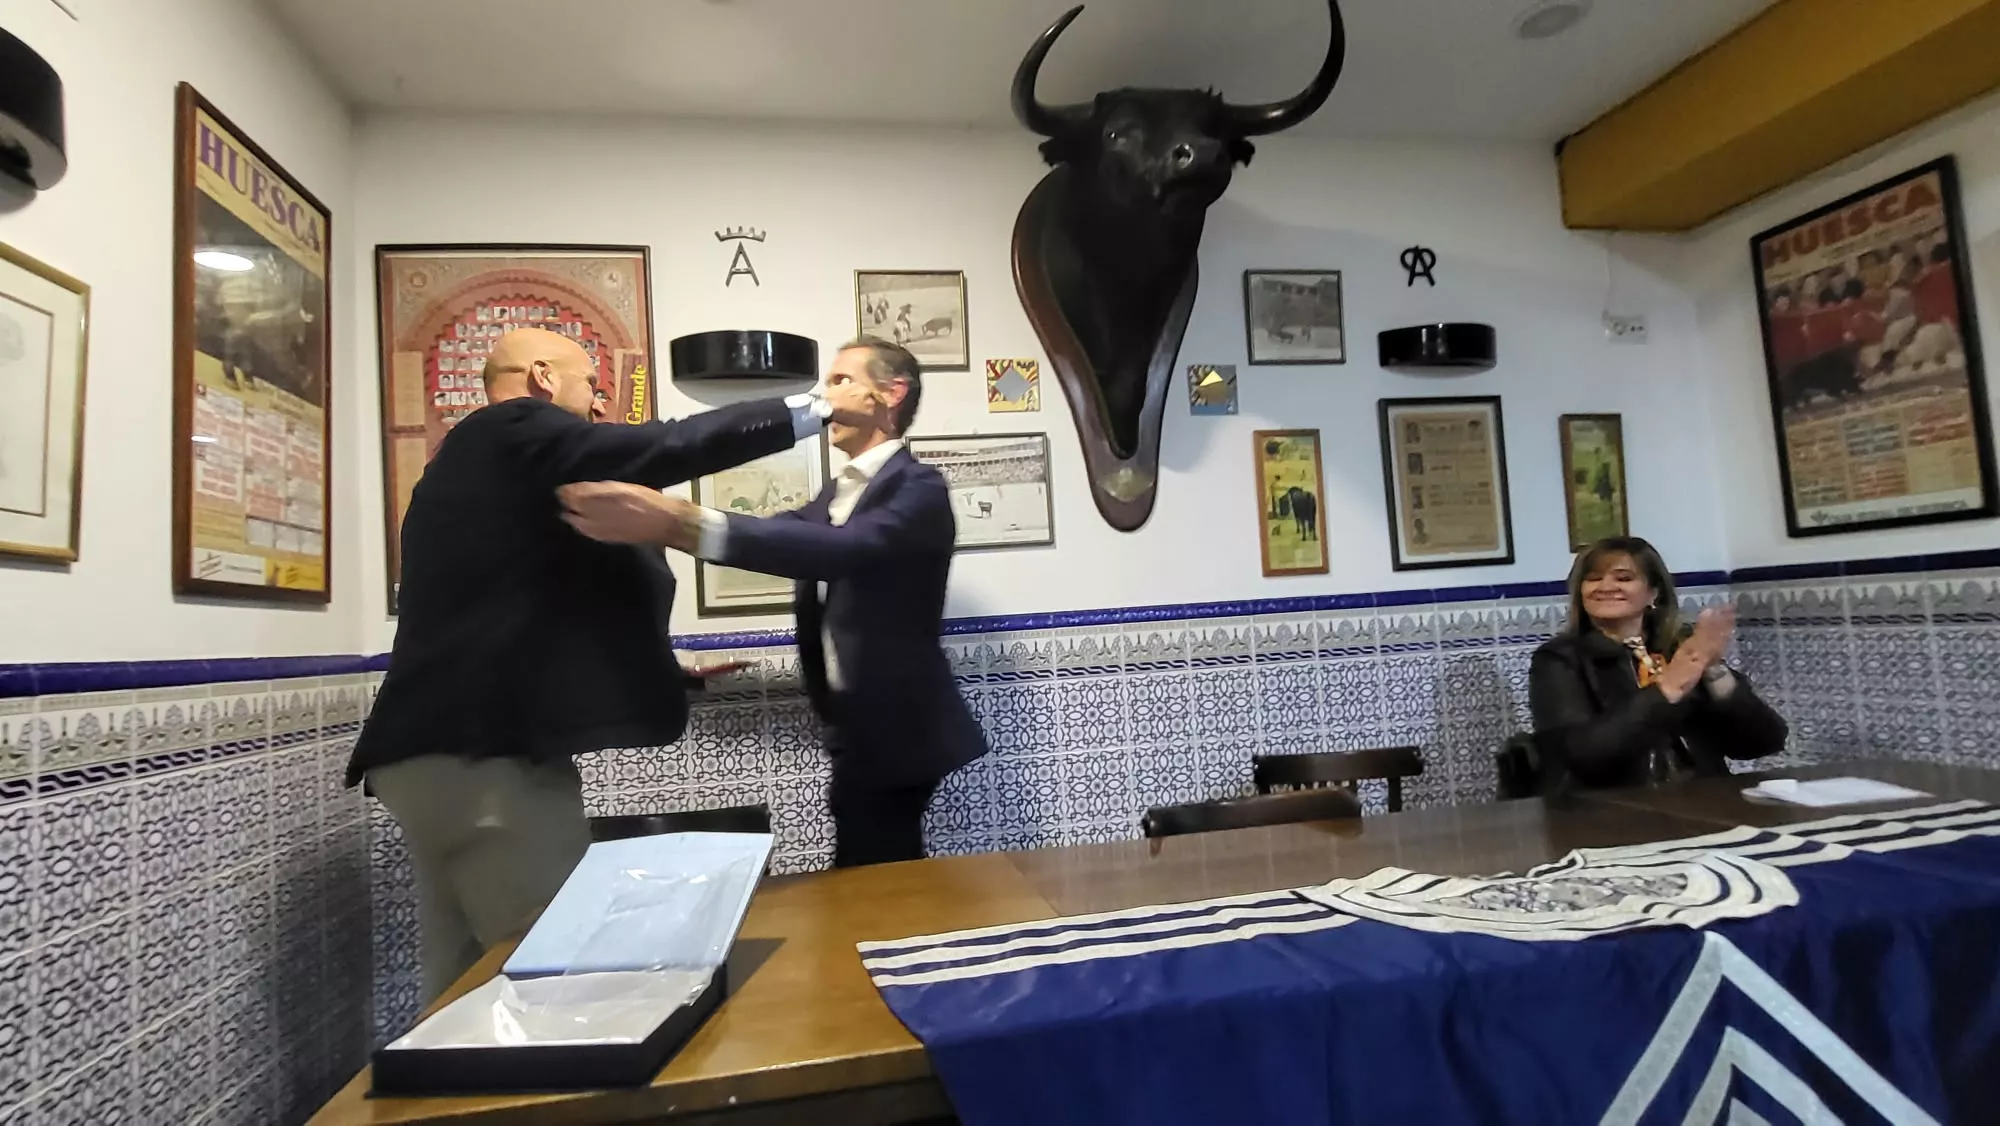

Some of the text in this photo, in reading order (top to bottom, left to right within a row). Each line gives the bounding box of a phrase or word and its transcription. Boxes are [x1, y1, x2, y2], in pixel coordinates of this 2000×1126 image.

[200, 123, 321, 254] HUESCA
[1763, 181, 1939, 270] HUESCA
[625, 363, 647, 426] Grande
